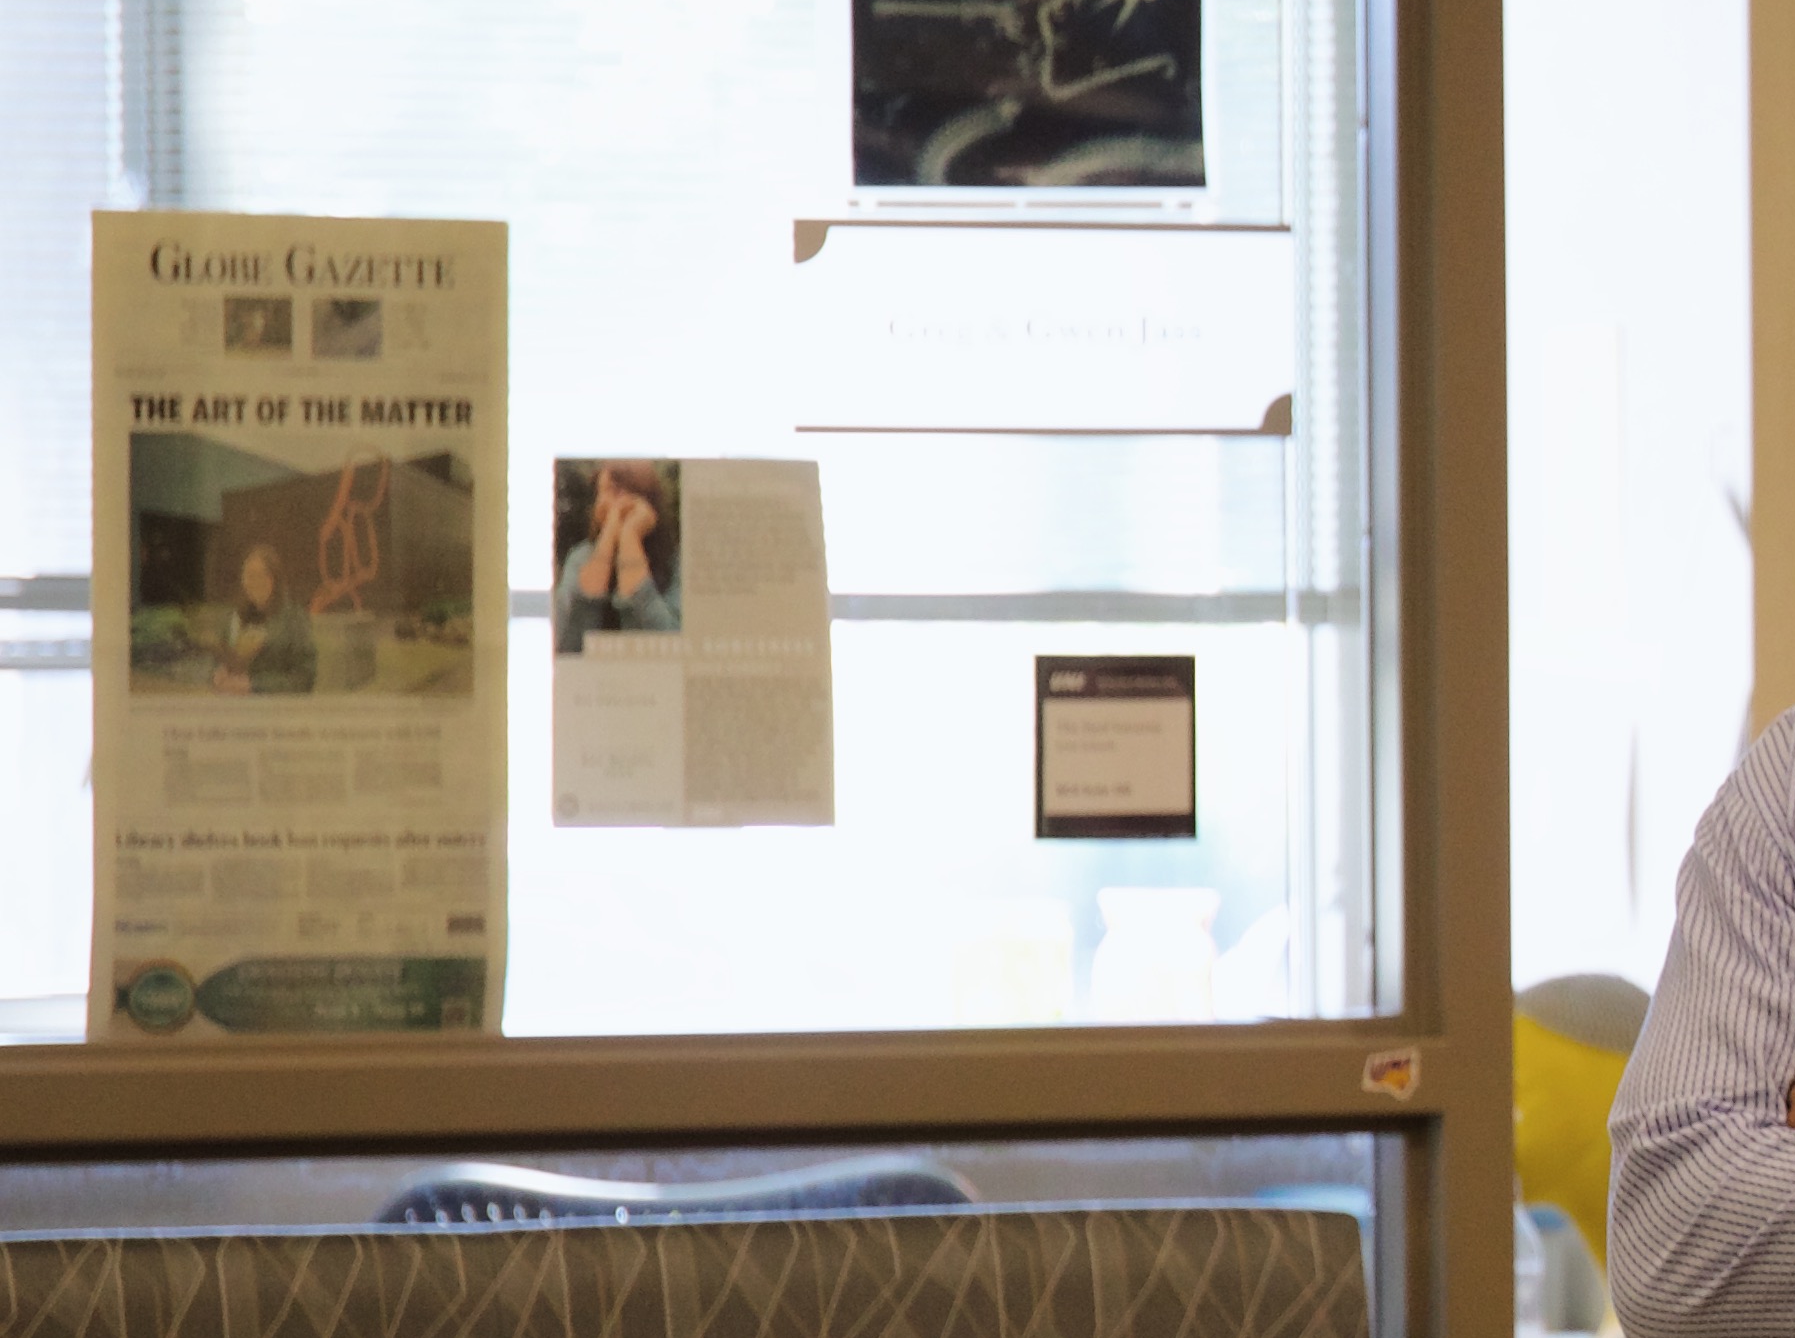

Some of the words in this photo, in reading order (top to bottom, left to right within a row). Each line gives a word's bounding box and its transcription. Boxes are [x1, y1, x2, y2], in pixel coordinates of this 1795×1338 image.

[130, 393, 181, 424] THE
[191, 393, 248, 425] ART
[256, 395, 290, 425] OF
[299, 395, 352, 426] THE
[360, 395, 474, 427] MATTER
